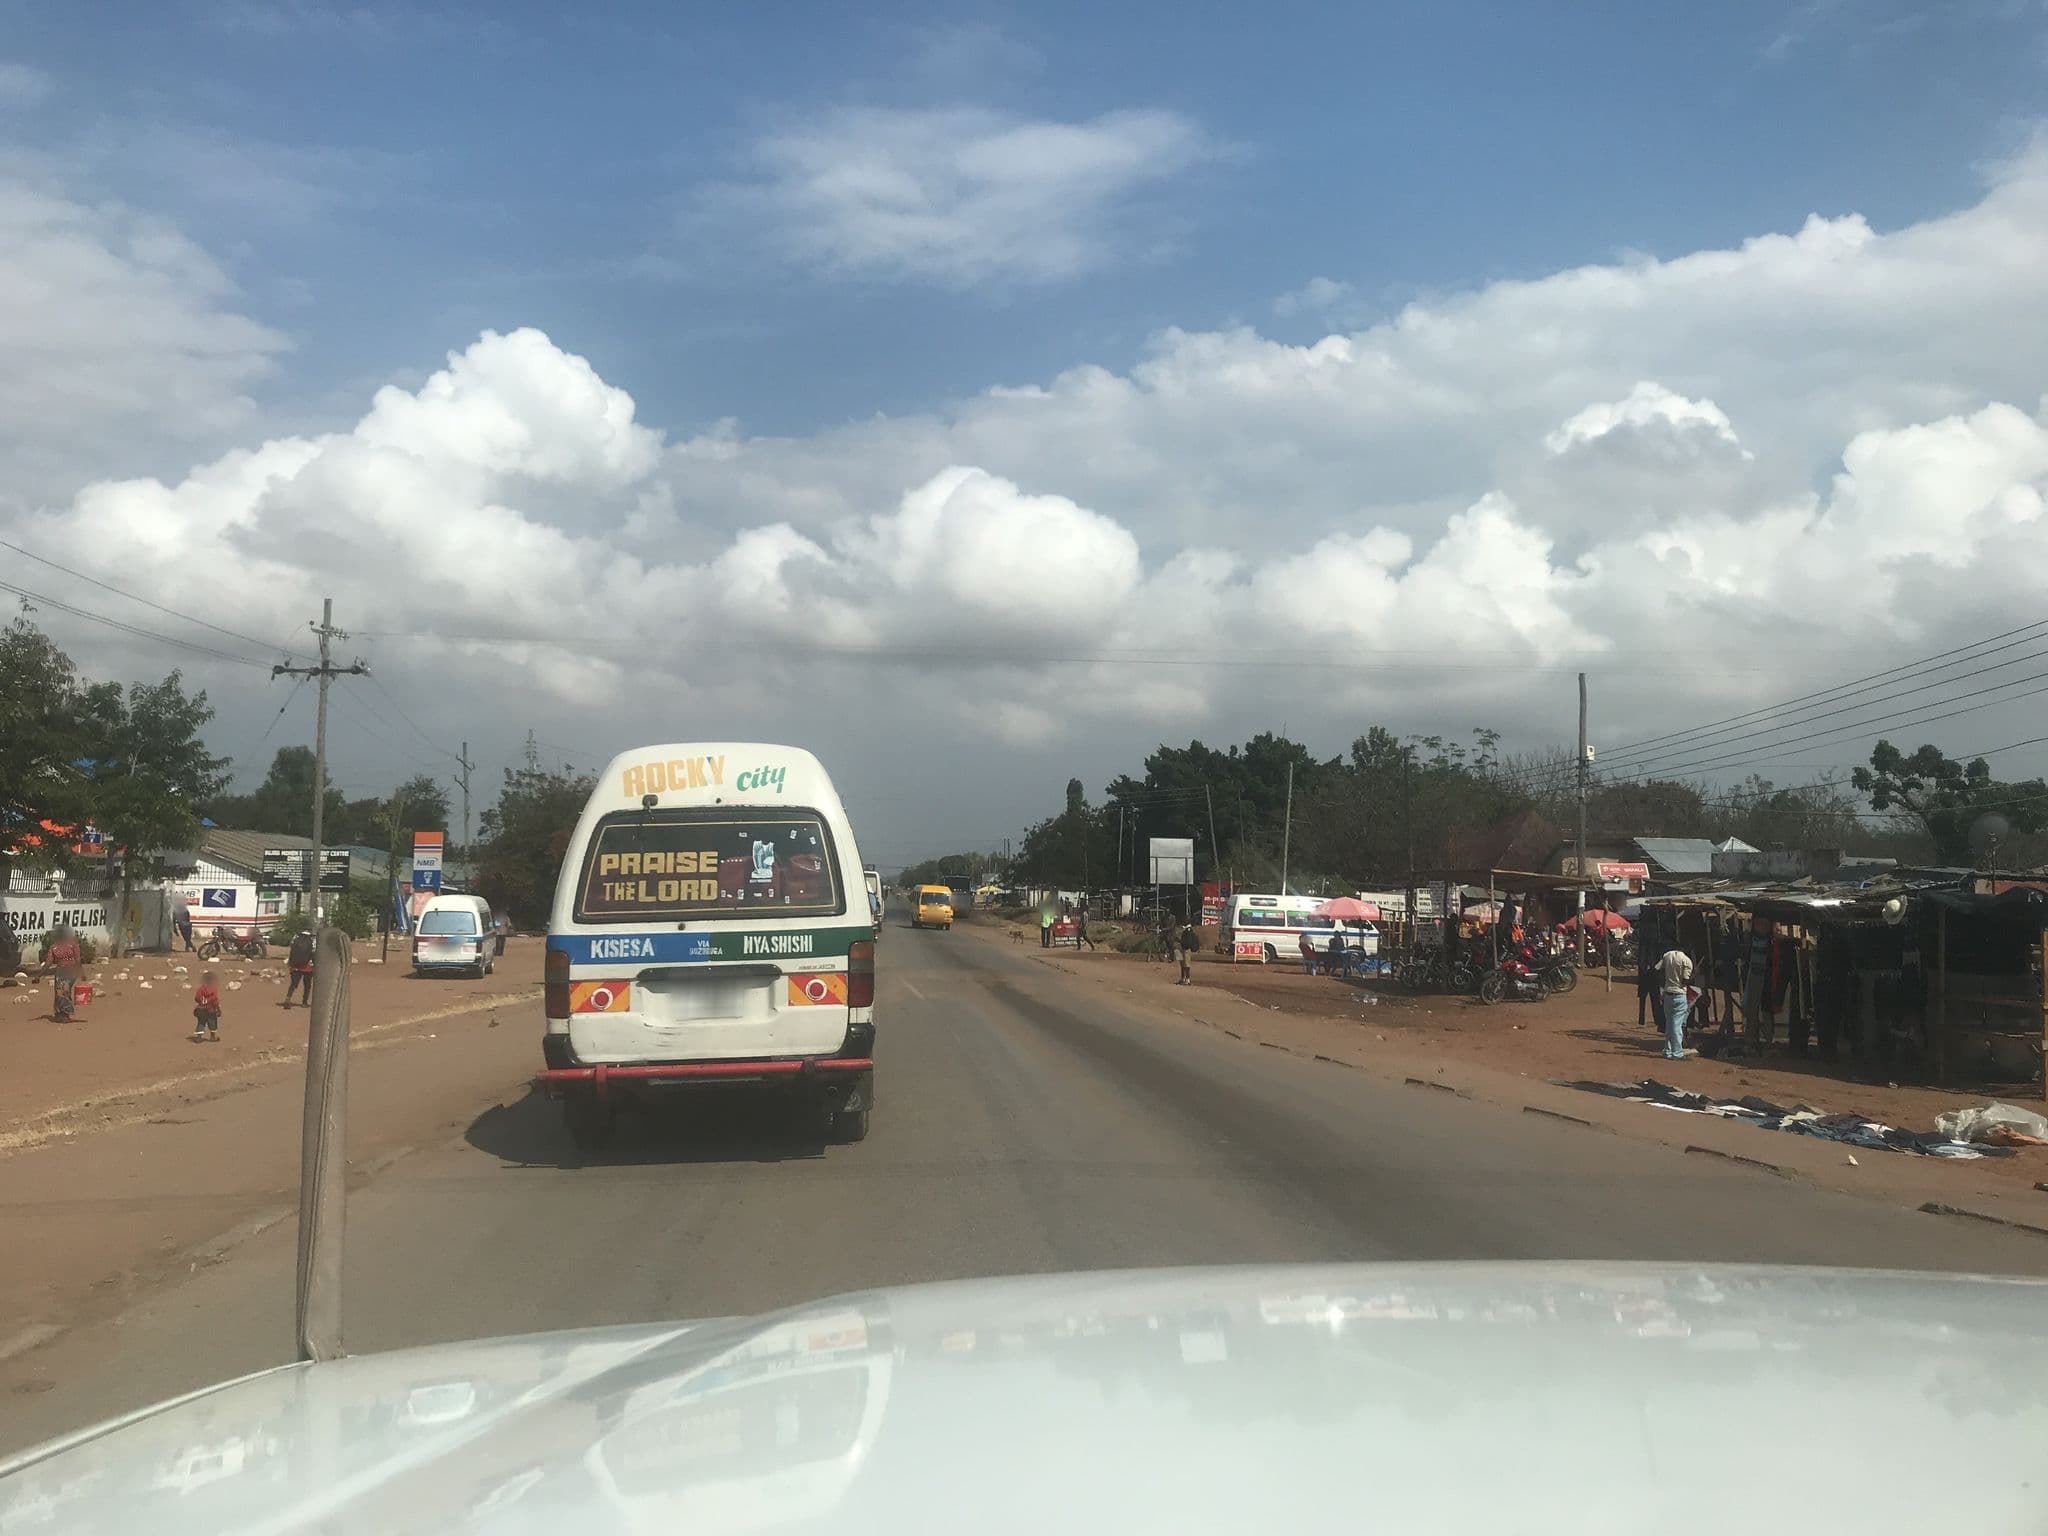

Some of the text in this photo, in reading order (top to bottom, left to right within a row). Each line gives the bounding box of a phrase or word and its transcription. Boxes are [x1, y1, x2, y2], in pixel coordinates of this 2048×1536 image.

[623, 755, 786, 797] ROCKY city
[416, 859, 435, 867] NMB
[600, 851, 718, 876] PRAISE
[603, 879, 718, 903] THE LORD
[53, 909, 107, 928] ENGLISH
[590, 935, 813, 959] KISESA VIA NYASHISHI
